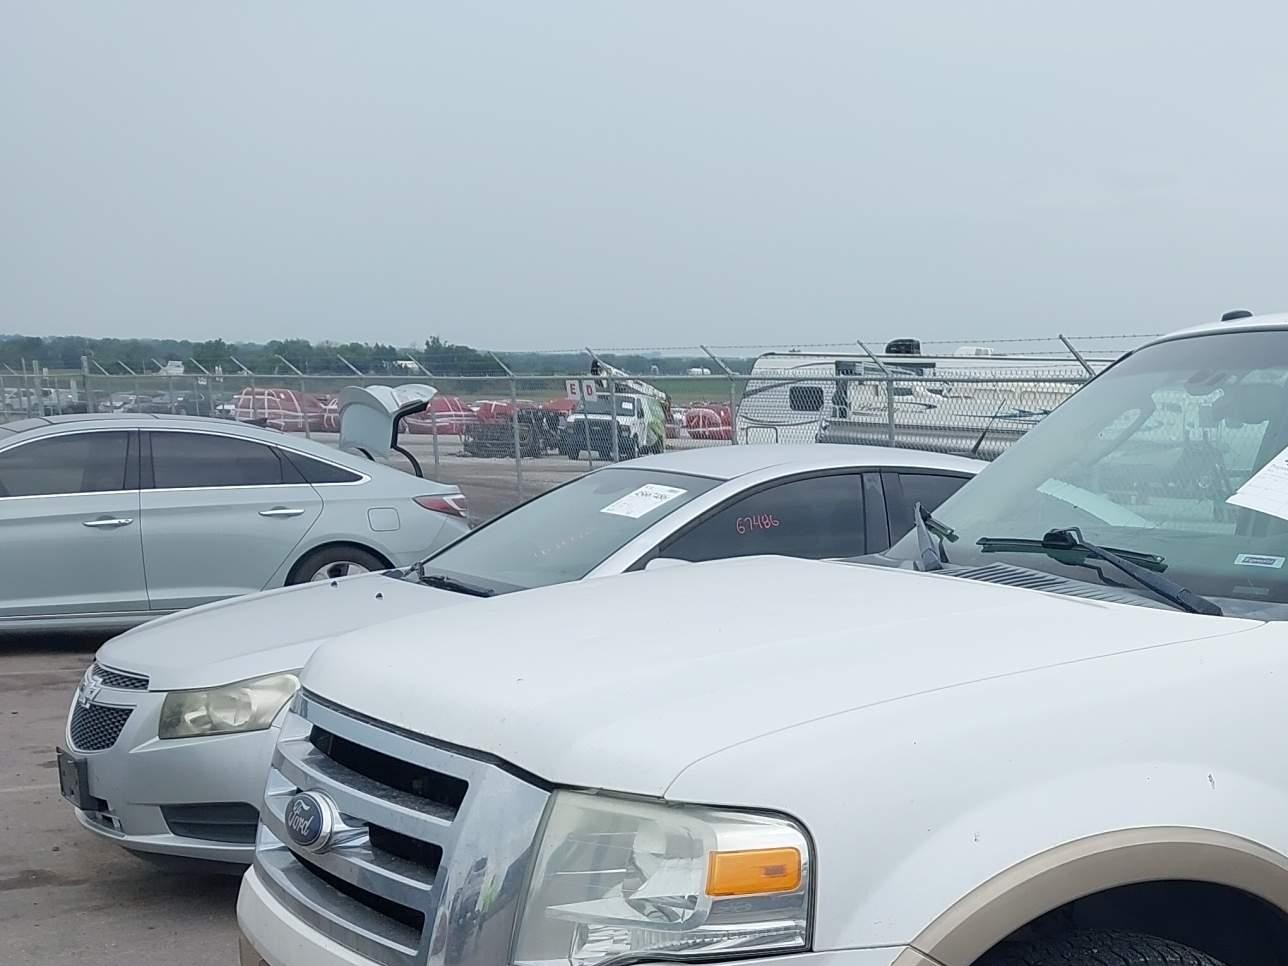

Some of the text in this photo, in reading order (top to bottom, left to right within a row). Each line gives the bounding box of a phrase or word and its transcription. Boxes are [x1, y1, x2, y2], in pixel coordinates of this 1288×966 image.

[569, 383, 577, 395] E
[736, 514, 780, 534] 67486
[288, 799, 315, 836] Ford
